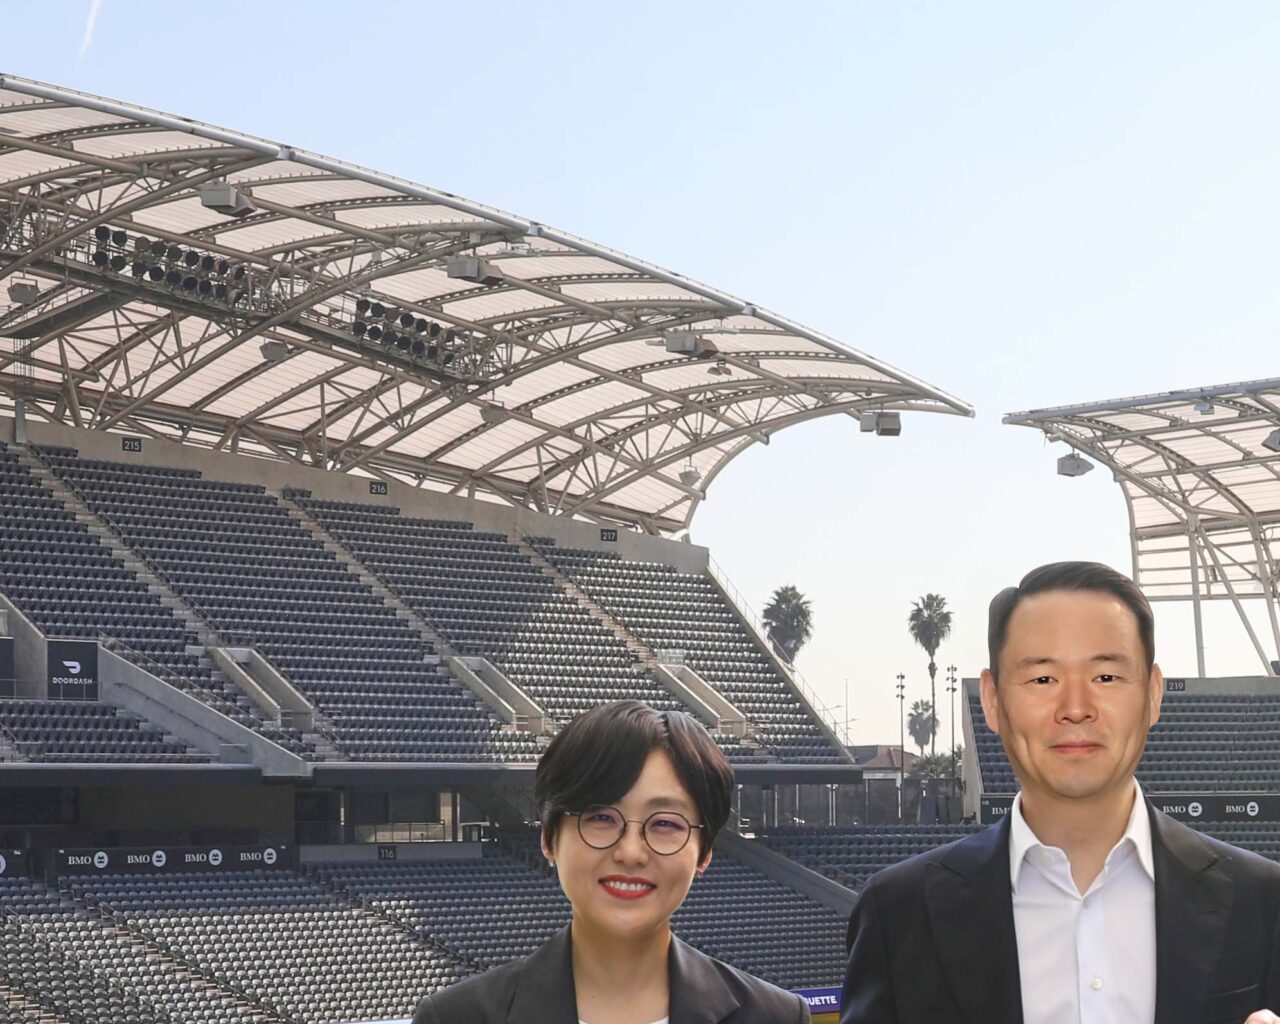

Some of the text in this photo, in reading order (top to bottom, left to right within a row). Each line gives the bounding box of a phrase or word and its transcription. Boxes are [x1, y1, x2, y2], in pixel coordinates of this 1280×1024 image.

[124, 440, 140, 450] 215
[371, 484, 386, 494] 216
[602, 531, 616, 540] 217
[52, 677, 93, 685] DOORDASH
[1169, 682, 1184, 690] 219
[1163, 806, 1186, 815] BMO
[1225, 805, 1246, 813] BMO
[68, 856, 92, 865] BMO
[127, 854, 150, 864] BMO
[185, 853, 207, 863] BMO
[240, 852, 262, 862] BMO
